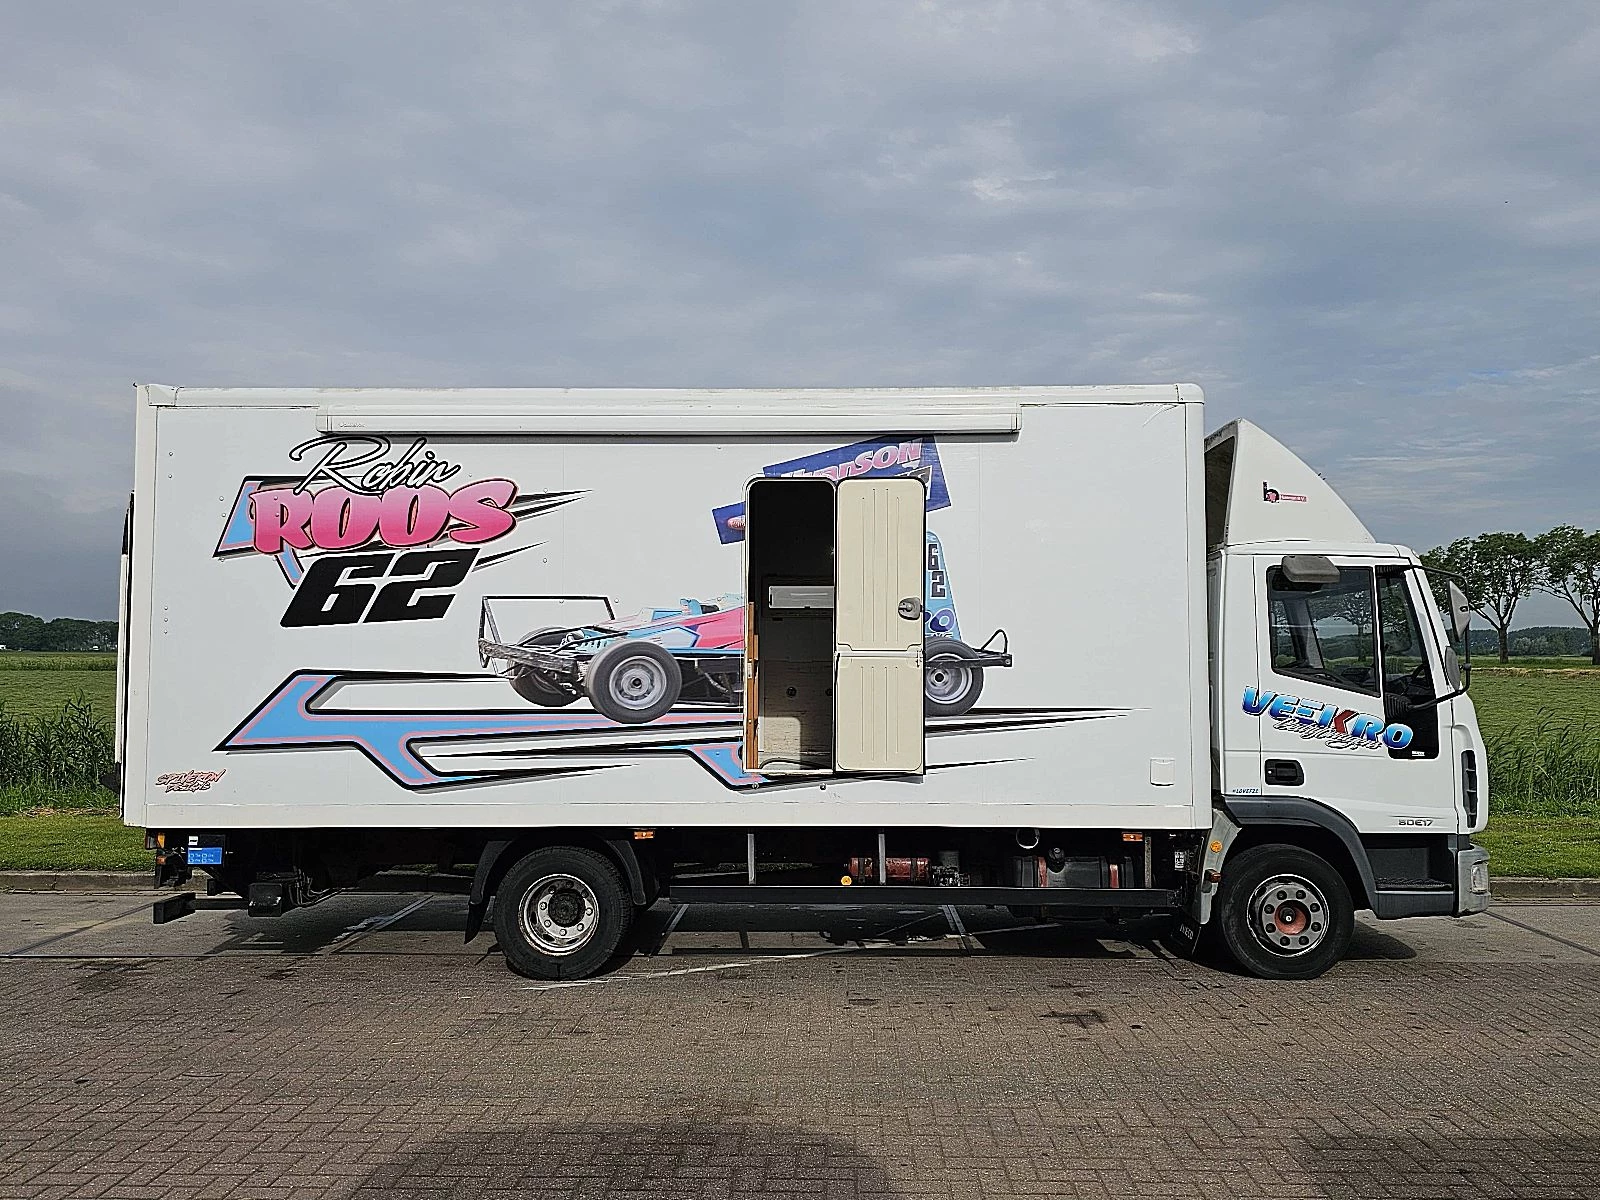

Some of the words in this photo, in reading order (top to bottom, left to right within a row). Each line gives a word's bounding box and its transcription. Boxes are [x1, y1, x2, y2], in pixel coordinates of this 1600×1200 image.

[288, 435, 461, 496] Robin
[249, 477, 519, 554] ROOS
[280, 547, 481, 628] 62
[1242, 685, 1413, 749] VEEKRO
